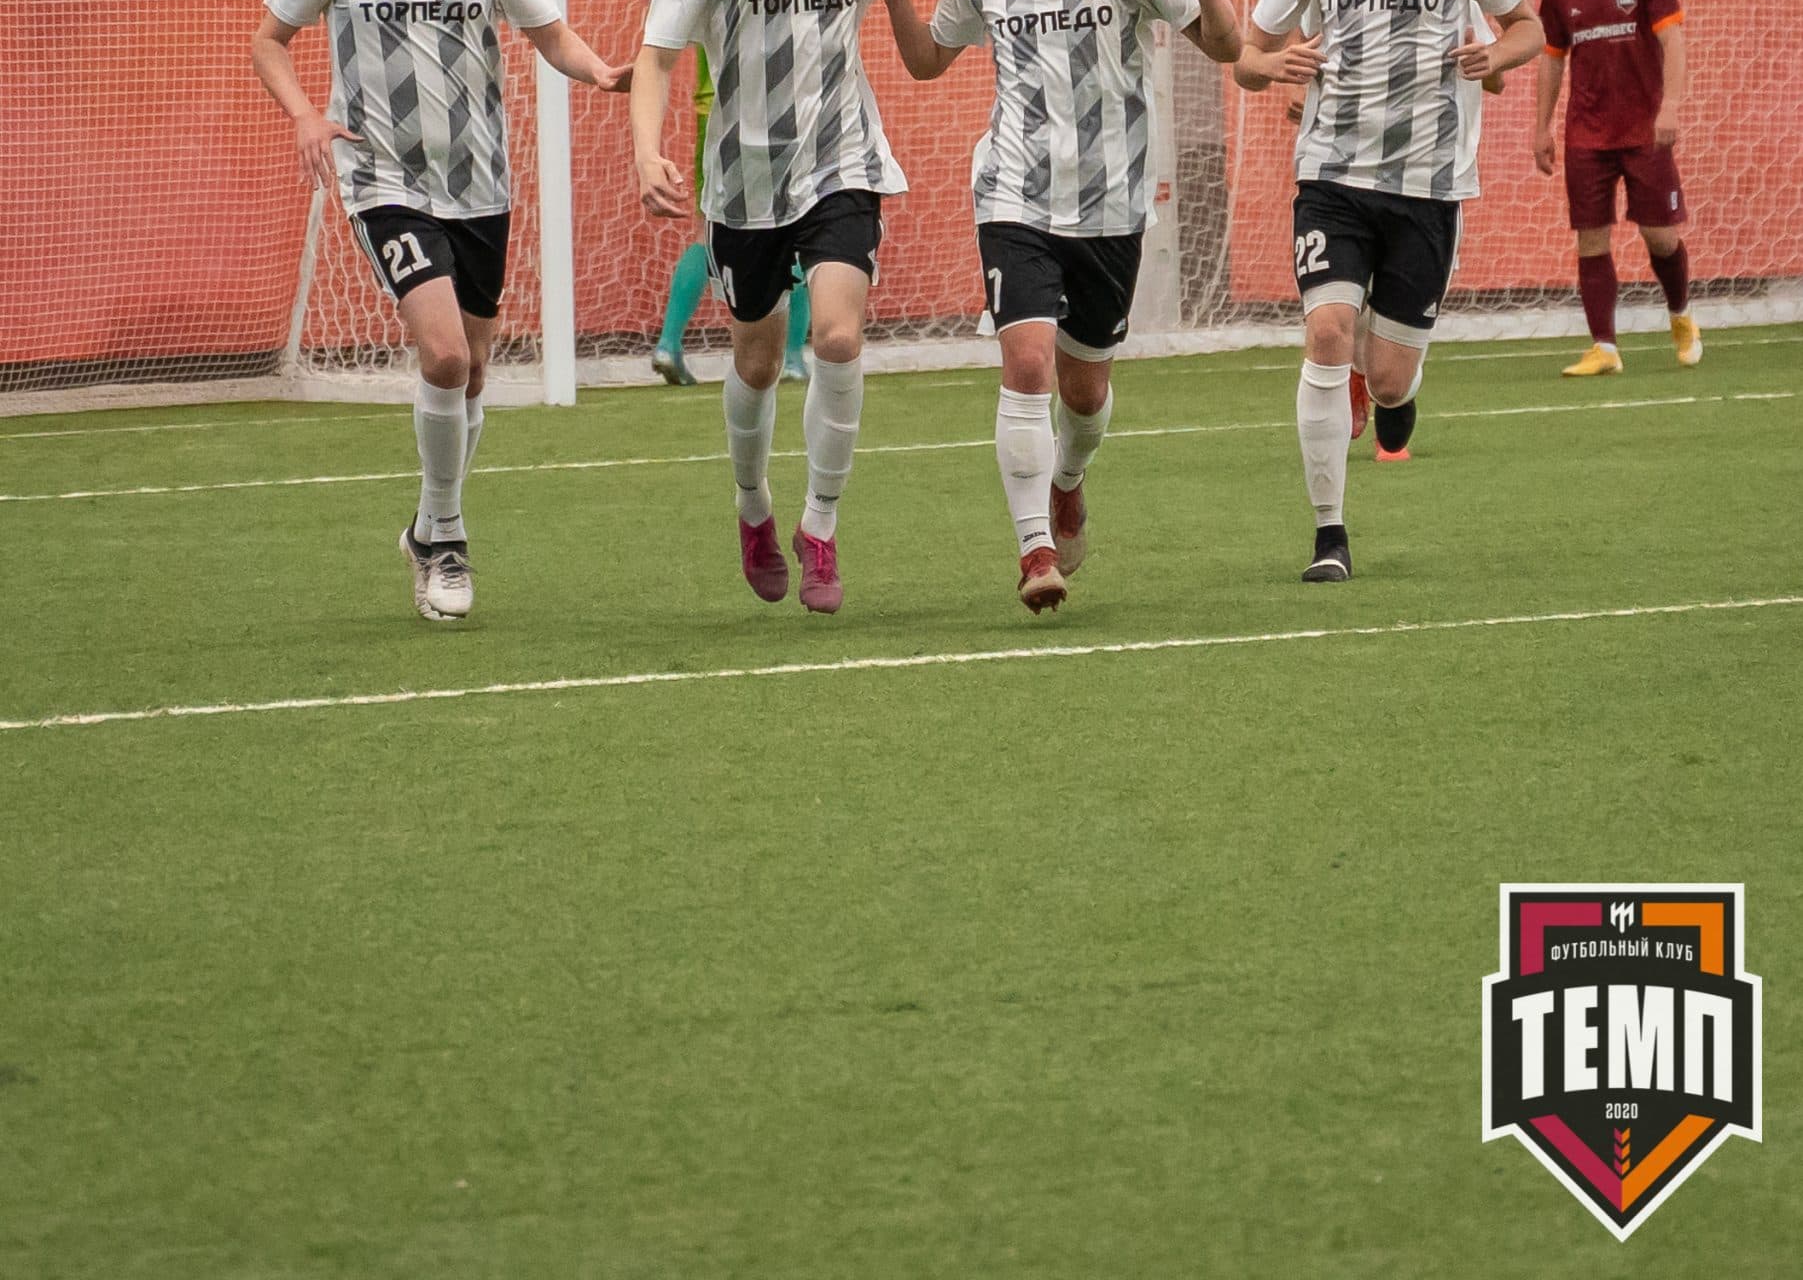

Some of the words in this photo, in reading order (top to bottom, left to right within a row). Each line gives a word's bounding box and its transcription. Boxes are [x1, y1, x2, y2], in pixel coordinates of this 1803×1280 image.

[359, 1, 482, 24] ТОРПЕДО
[995, 5, 1113, 38] ТОРПЕДО
[382, 231, 433, 283] 21
[1295, 229, 1330, 279] 22
